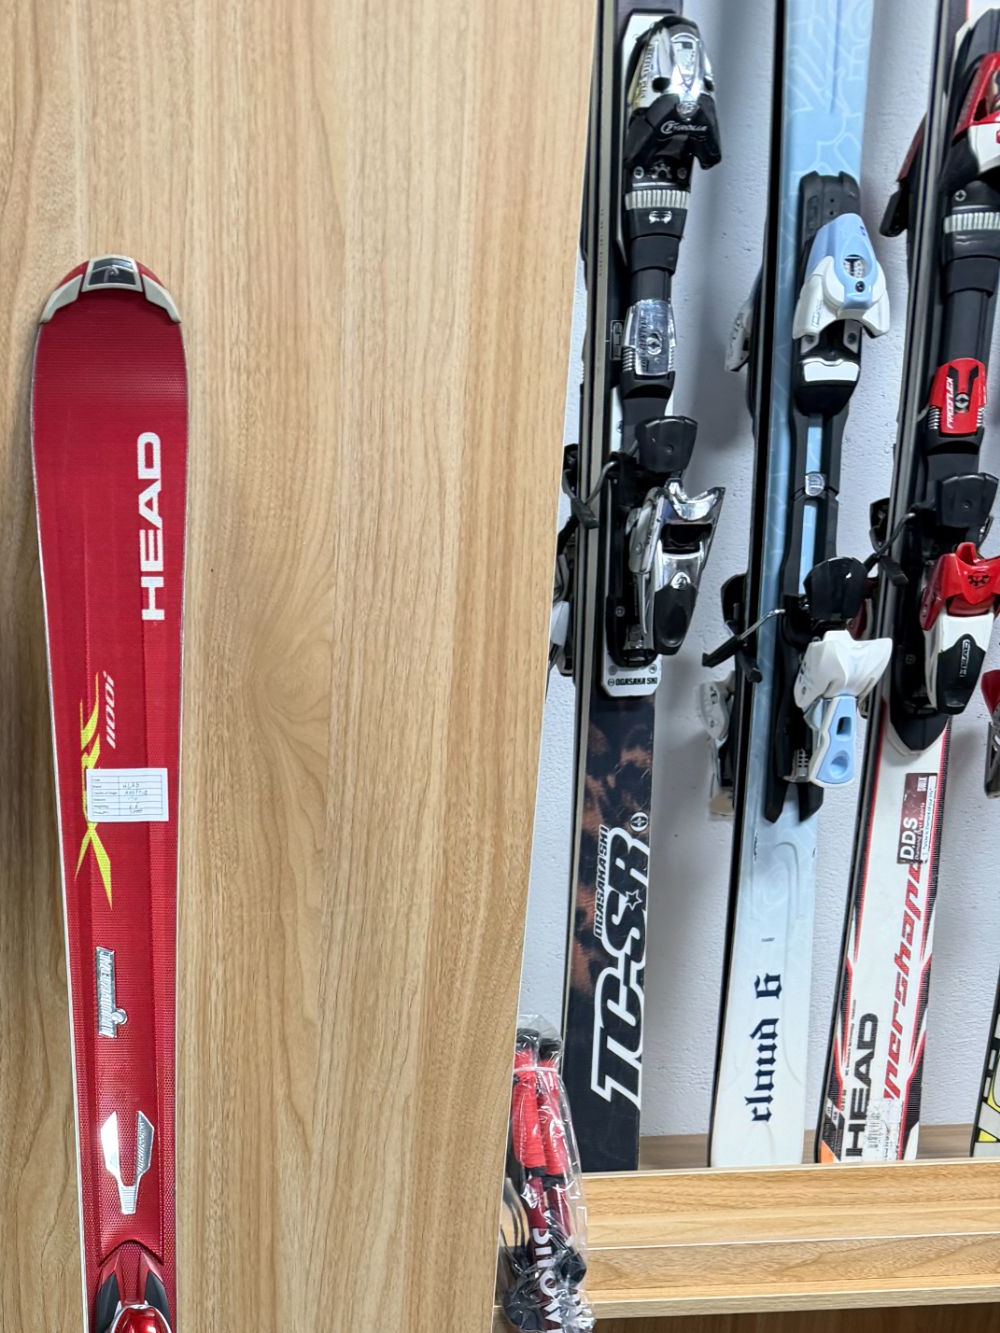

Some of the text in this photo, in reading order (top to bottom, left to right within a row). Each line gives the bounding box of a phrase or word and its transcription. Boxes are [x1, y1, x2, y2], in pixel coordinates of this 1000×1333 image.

[137, 431, 165, 621] HEAD
[103, 671, 116, 750] 1100i
[594, 824, 609, 937] OGASAKA SKI
[884, 862, 921, 1100] pershape
[745, 1018, 780, 1123] cloud
[846, 1012, 878, 1157] HEAD
